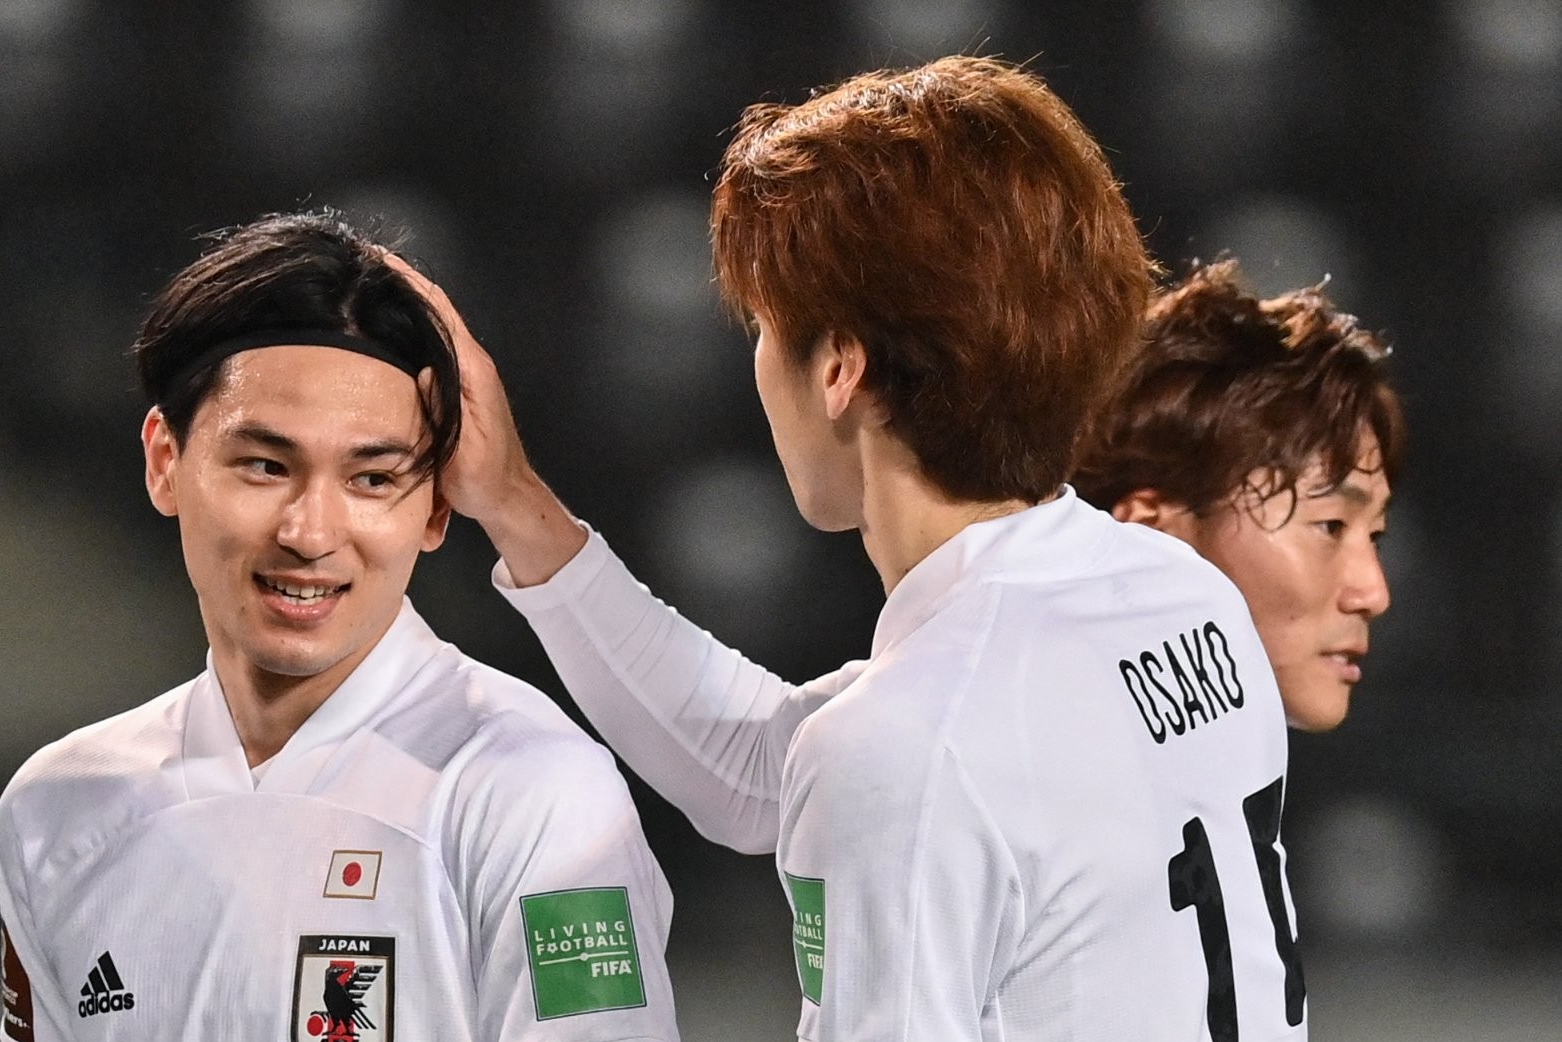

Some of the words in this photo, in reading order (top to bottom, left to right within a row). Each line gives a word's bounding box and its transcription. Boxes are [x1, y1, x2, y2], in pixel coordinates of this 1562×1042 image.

[1119, 621, 1245, 745] OSAKO
[534, 920, 626, 942] LIVING
[318, 939, 370, 951] JAPAN
[536, 934, 628, 956] FOOTBALL
[591, 959, 632, 978] FIFA
[78, 990, 135, 1018] adidas
